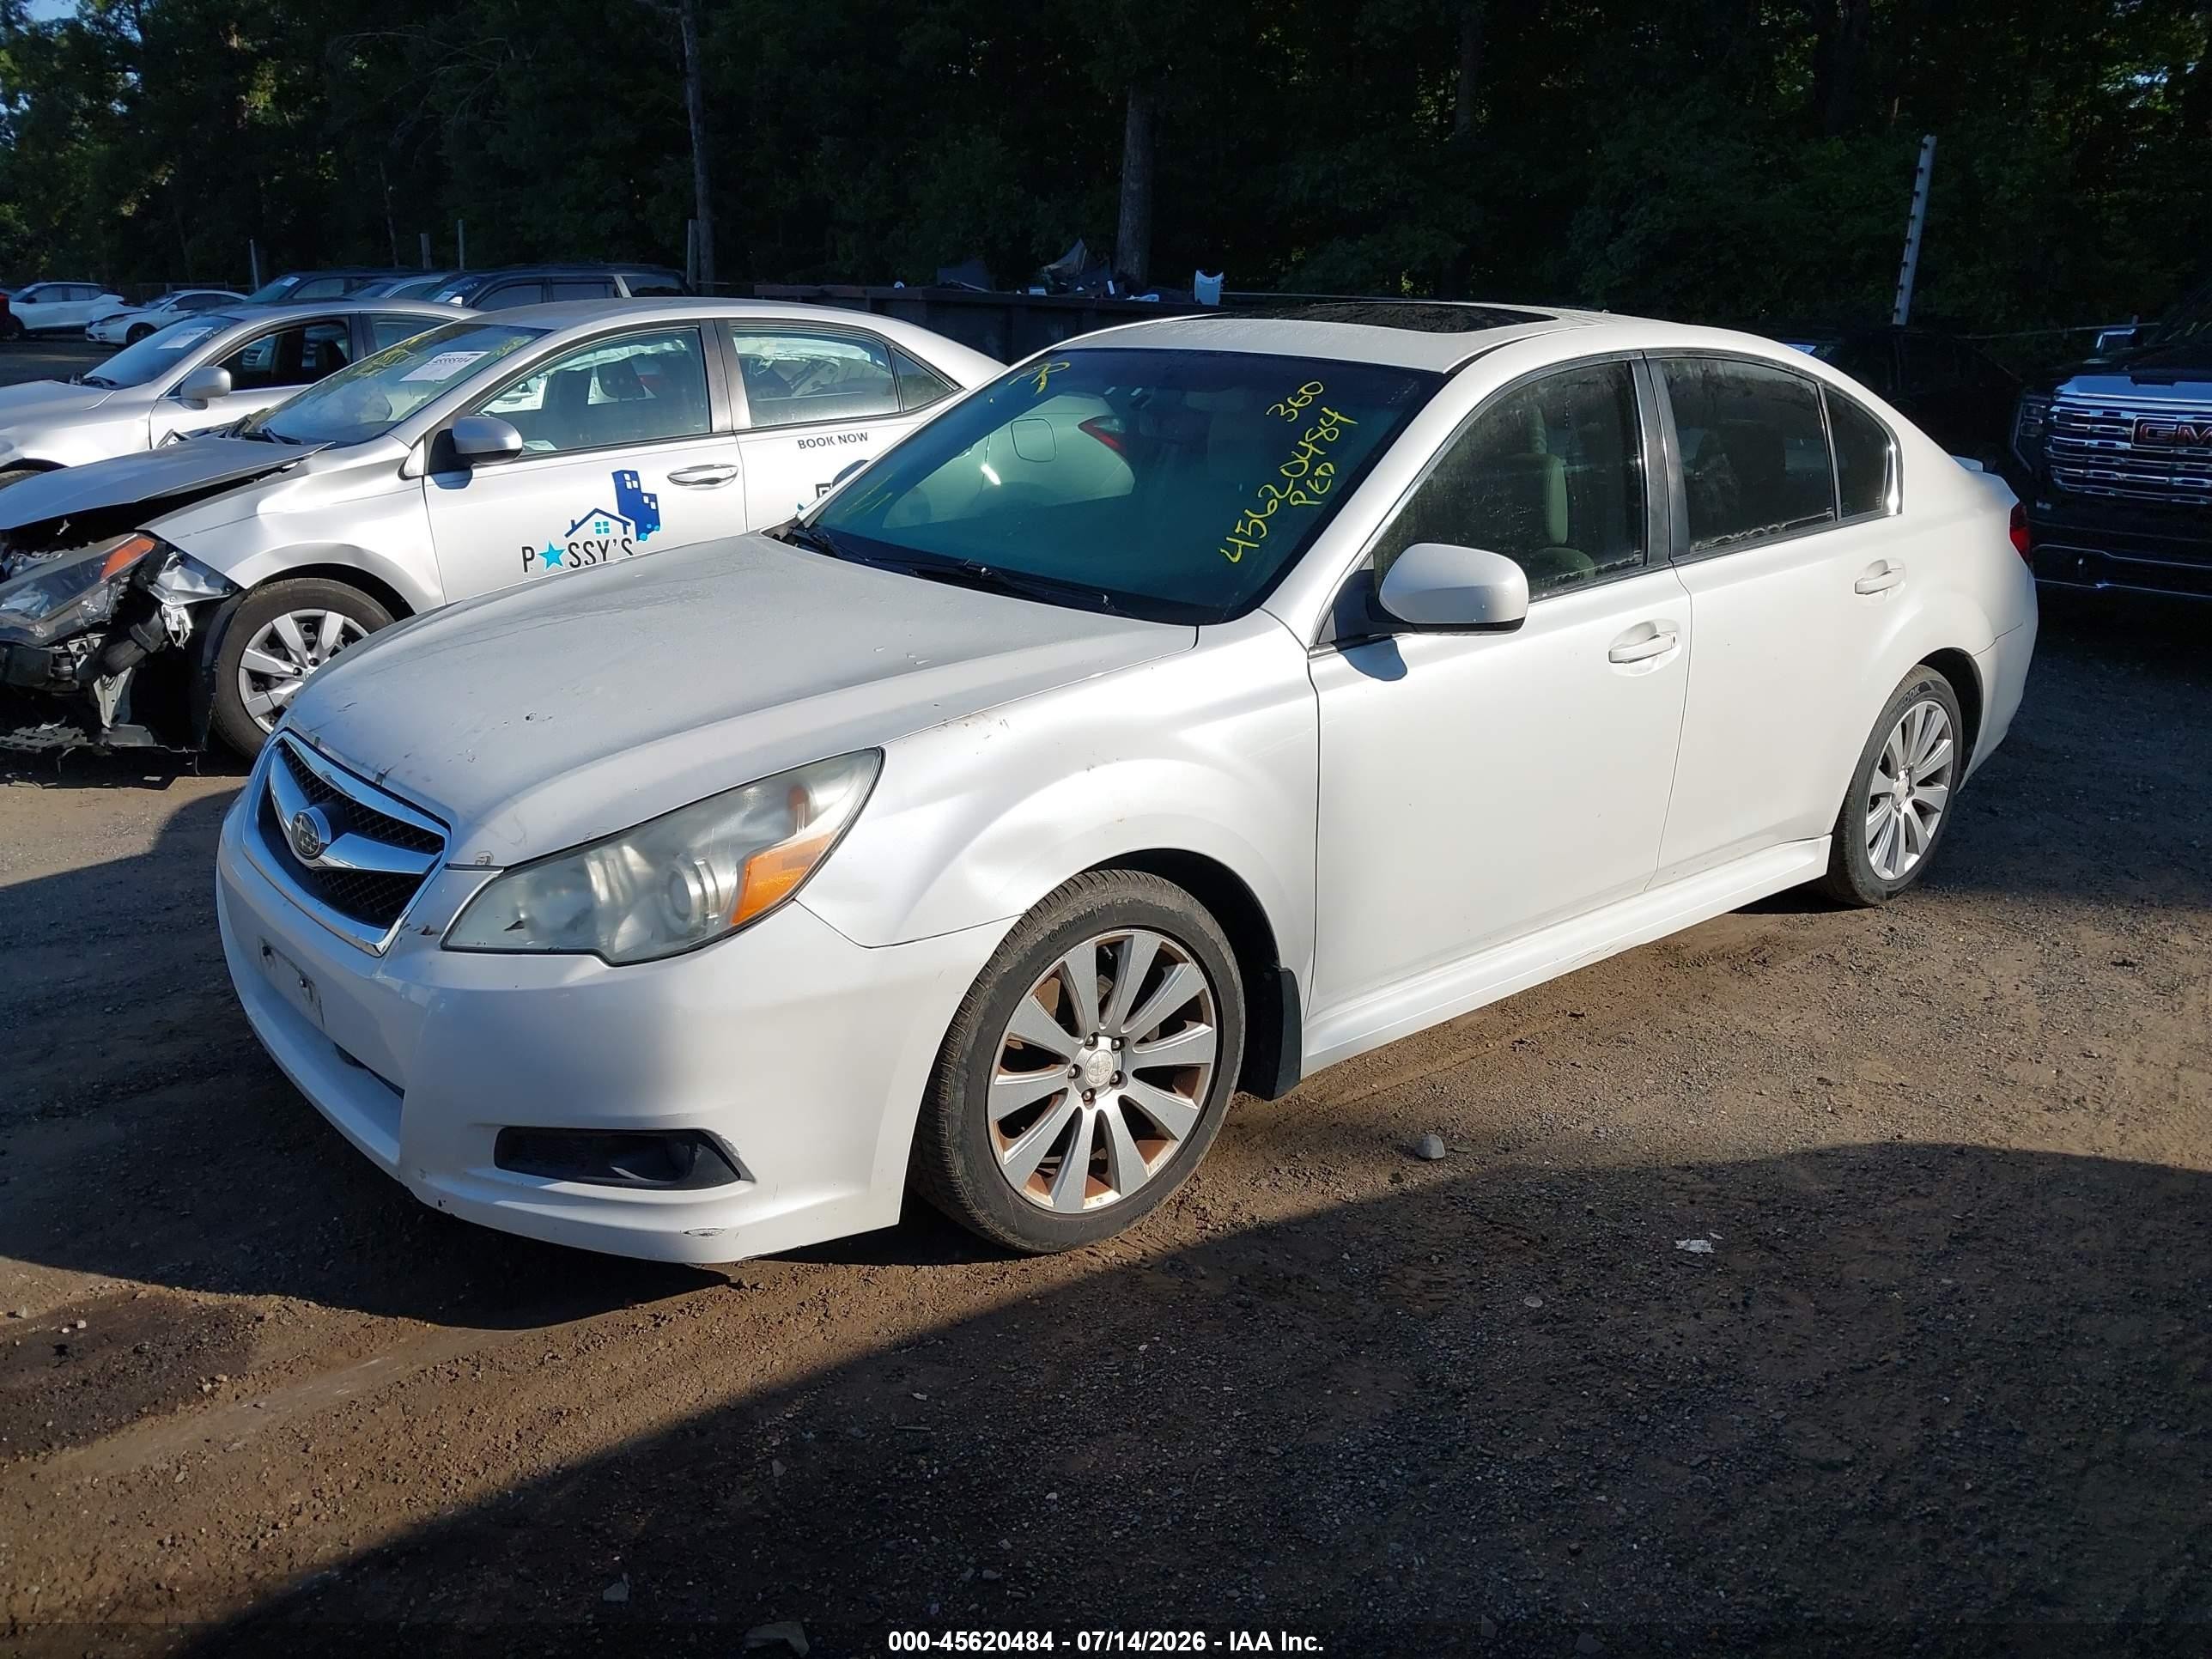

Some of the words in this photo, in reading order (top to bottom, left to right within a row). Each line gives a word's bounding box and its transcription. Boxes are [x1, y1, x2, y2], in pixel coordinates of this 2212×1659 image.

[1266, 380, 1324, 422] 360
[797, 435, 836, 449] BOOK
[837, 432, 868, 444] NOW
[1218, 406, 1359, 562] 45620484
